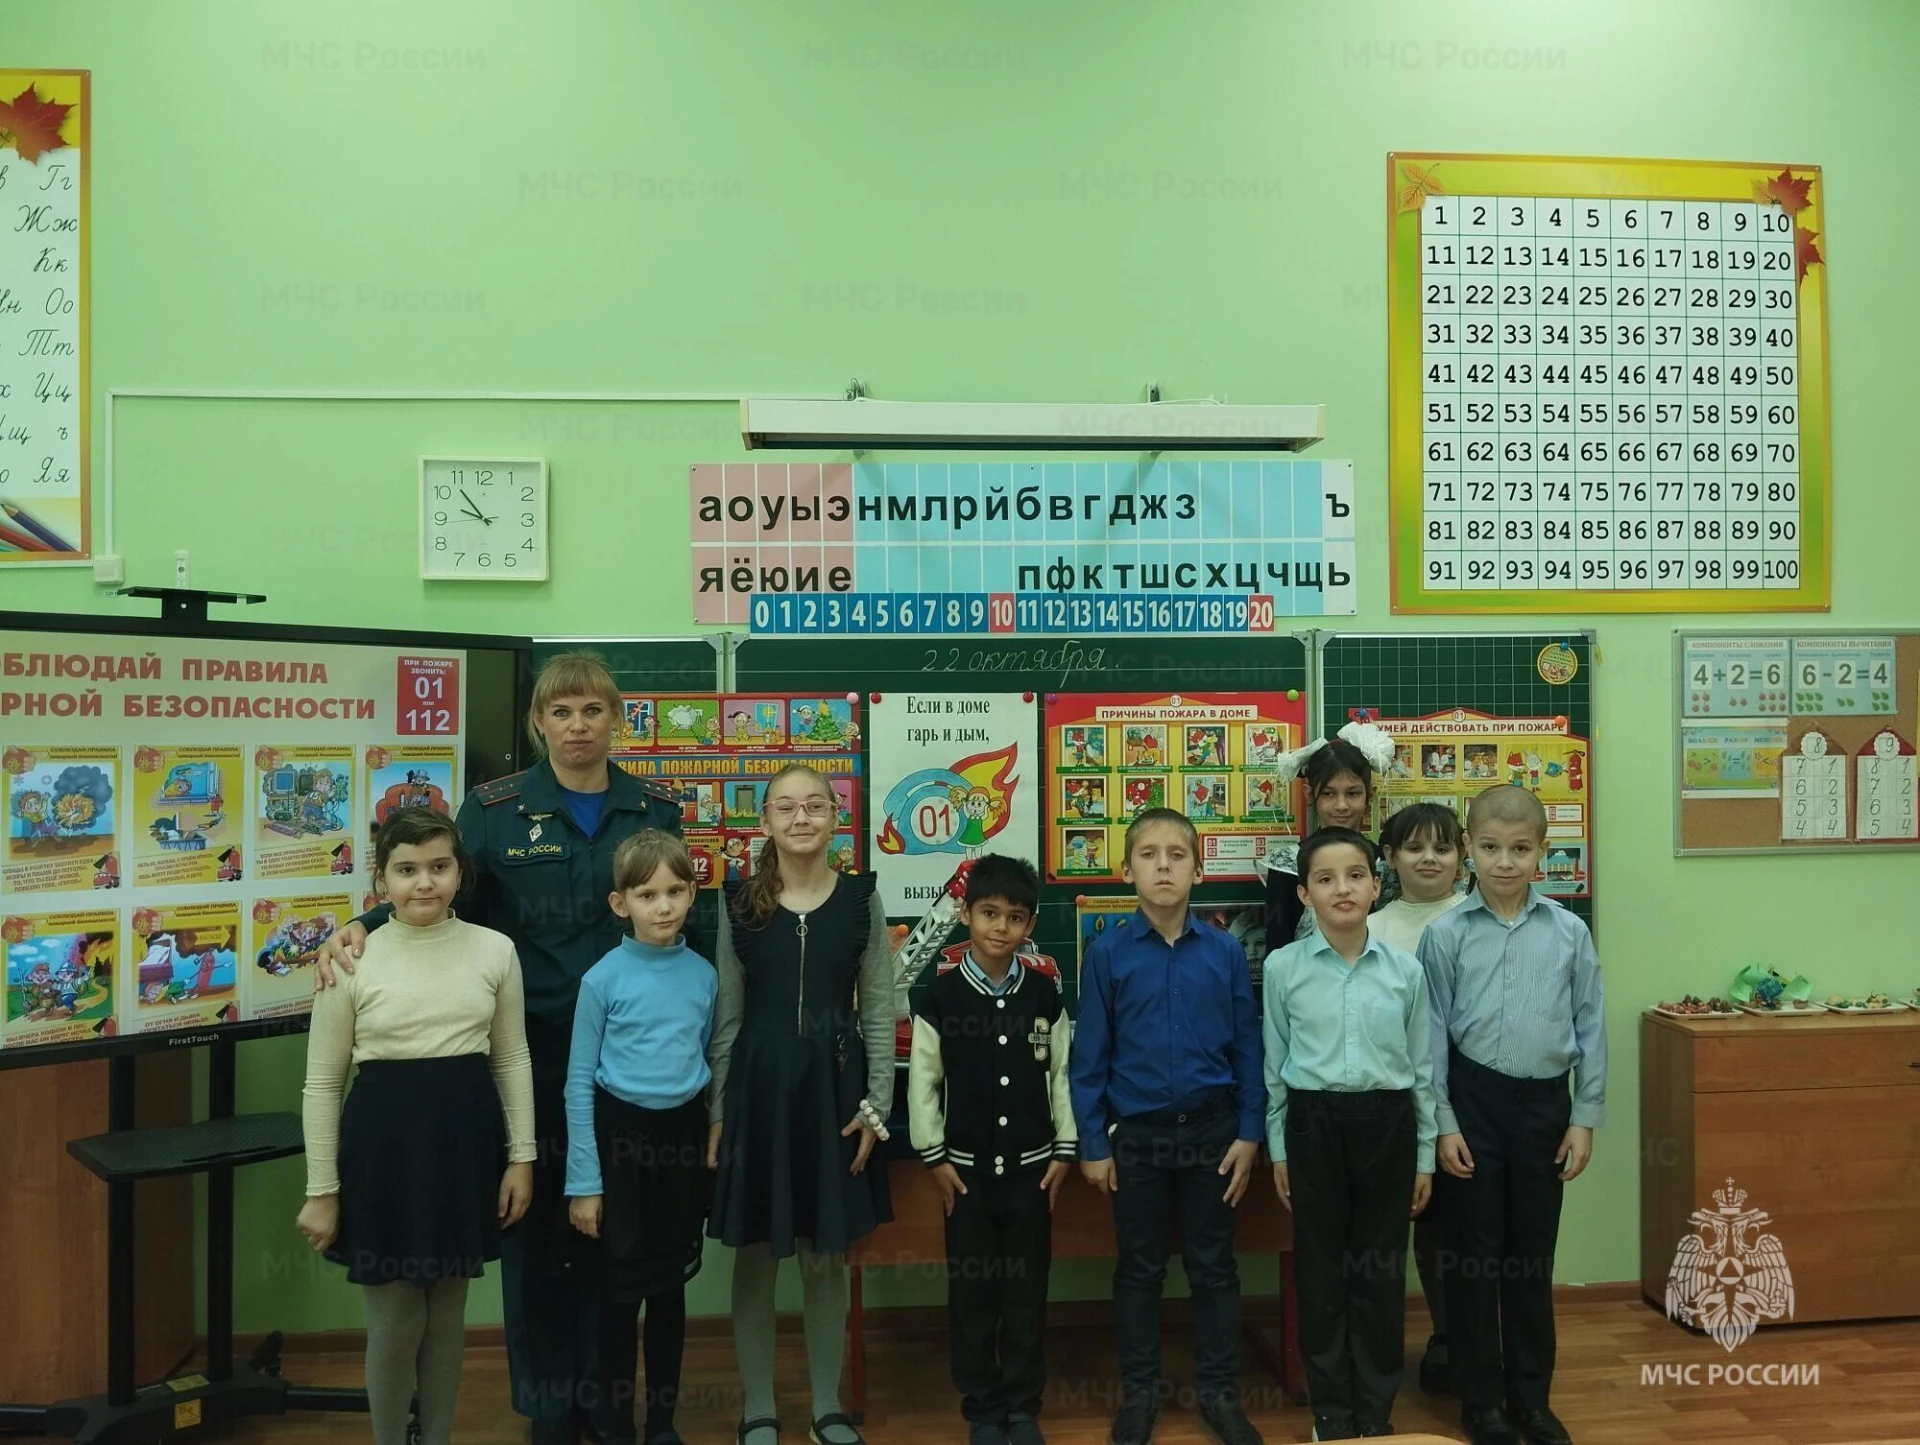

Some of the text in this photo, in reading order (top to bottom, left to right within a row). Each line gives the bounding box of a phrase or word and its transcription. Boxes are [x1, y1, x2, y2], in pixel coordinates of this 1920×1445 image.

[1435, 205, 1790, 233] 1 2 3 4 5 6 7 8 9 10
[451, 470, 463, 485] 11
[475, 470, 494, 486] 12
[508, 471, 513, 486] 1
[434, 485, 451, 500] 10
[520, 486, 534, 501] 2
[434, 511, 448, 526] 9
[520, 512, 535, 527] 3
[435, 536, 447, 551] 8
[520, 537, 535, 552] 4
[454, 552, 466, 567] 7
[478, 552, 492, 567] 6
[504, 553, 517, 567] 5
[1429, 559, 1799, 581] 91 92 93 94 95 96 97 98 99 100
[755, 599, 1273, 628] 0 1 2 3 4 5 6 7 8 9 10 11 12 13 14 15 16 17 18 19 20
[0, 652, 329, 684] БЛЮДАЙ ПРАВИЛА
[404, 659, 453, 668] ПРИ ПОЖАРЕ
[414, 676, 443, 699] 01
[1, 688, 375, 719] РНОЙ БЕЗОПАСНОСТИ
[906, 696, 991, 716] Если в доме
[1171, 697, 1181, 705] 01
[405, 709, 450, 731] 112
[1101, 709, 1251, 719] ПРИЧИНЫ ПОЖАРА В ДОМЕ
[1377, 722, 1564, 734] УМЕЙ ДЕЙСТВОВАТЬ ПРИ ПОЖАРЕ
[907, 727, 990, 746] гарь и дым,
[1886, 736, 1894, 753] 9
[1813, 736, 1822, 754] 8
[661, 757, 740, 775] ПОЖАРНОЙ
[1796, 758, 1837, 774] 7 1
[1870, 758, 1910, 774] 8 1
[1795, 779, 1838, 795] 6 2
[1870, 778, 1911, 795] 7 2
[1796, 799, 1838, 816] 5 3
[1870, 799, 1911, 815] 6 3
[919, 804, 951, 838] 01
[1796, 819, 1838, 836] 4 4
[1870, 819, 1911, 836] 5 4
[507, 844, 562, 857] МЧС РОССИИ
[168, 1033, 219, 1046] FirstTouch
